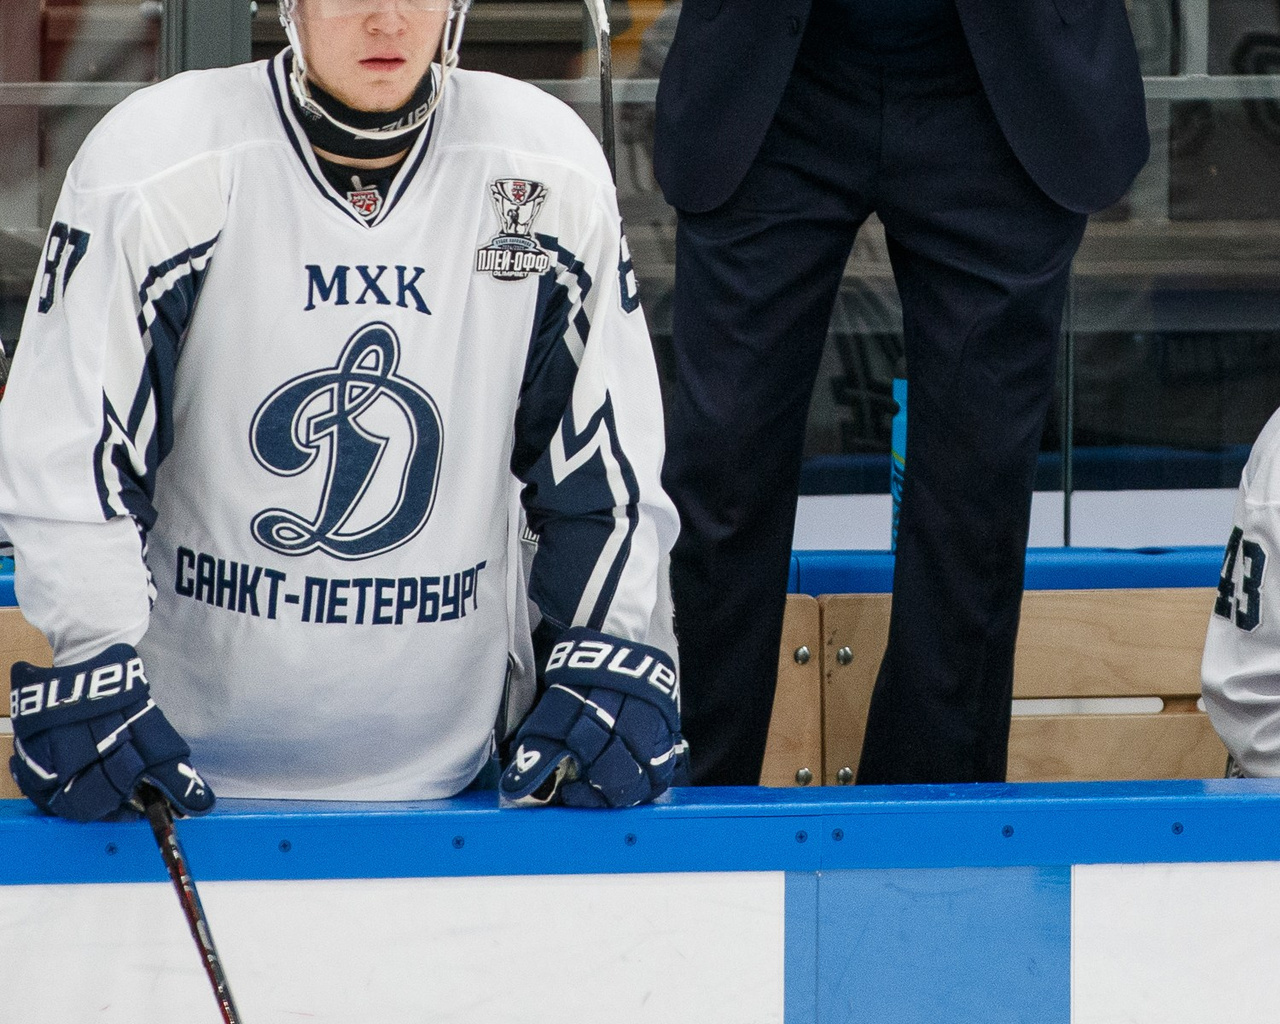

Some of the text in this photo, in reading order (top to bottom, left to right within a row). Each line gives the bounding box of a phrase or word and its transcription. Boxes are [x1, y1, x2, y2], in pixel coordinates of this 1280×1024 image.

[38, 220, 91, 314] 87
[303, 264, 432, 316] МХК
[478, 250, 549, 272] ПЛЕЙ-ОФФ
[175, 545, 487, 626] САНКТ-ПЕТЕРБУРГ
[1214, 525, 1267, 632] 43
